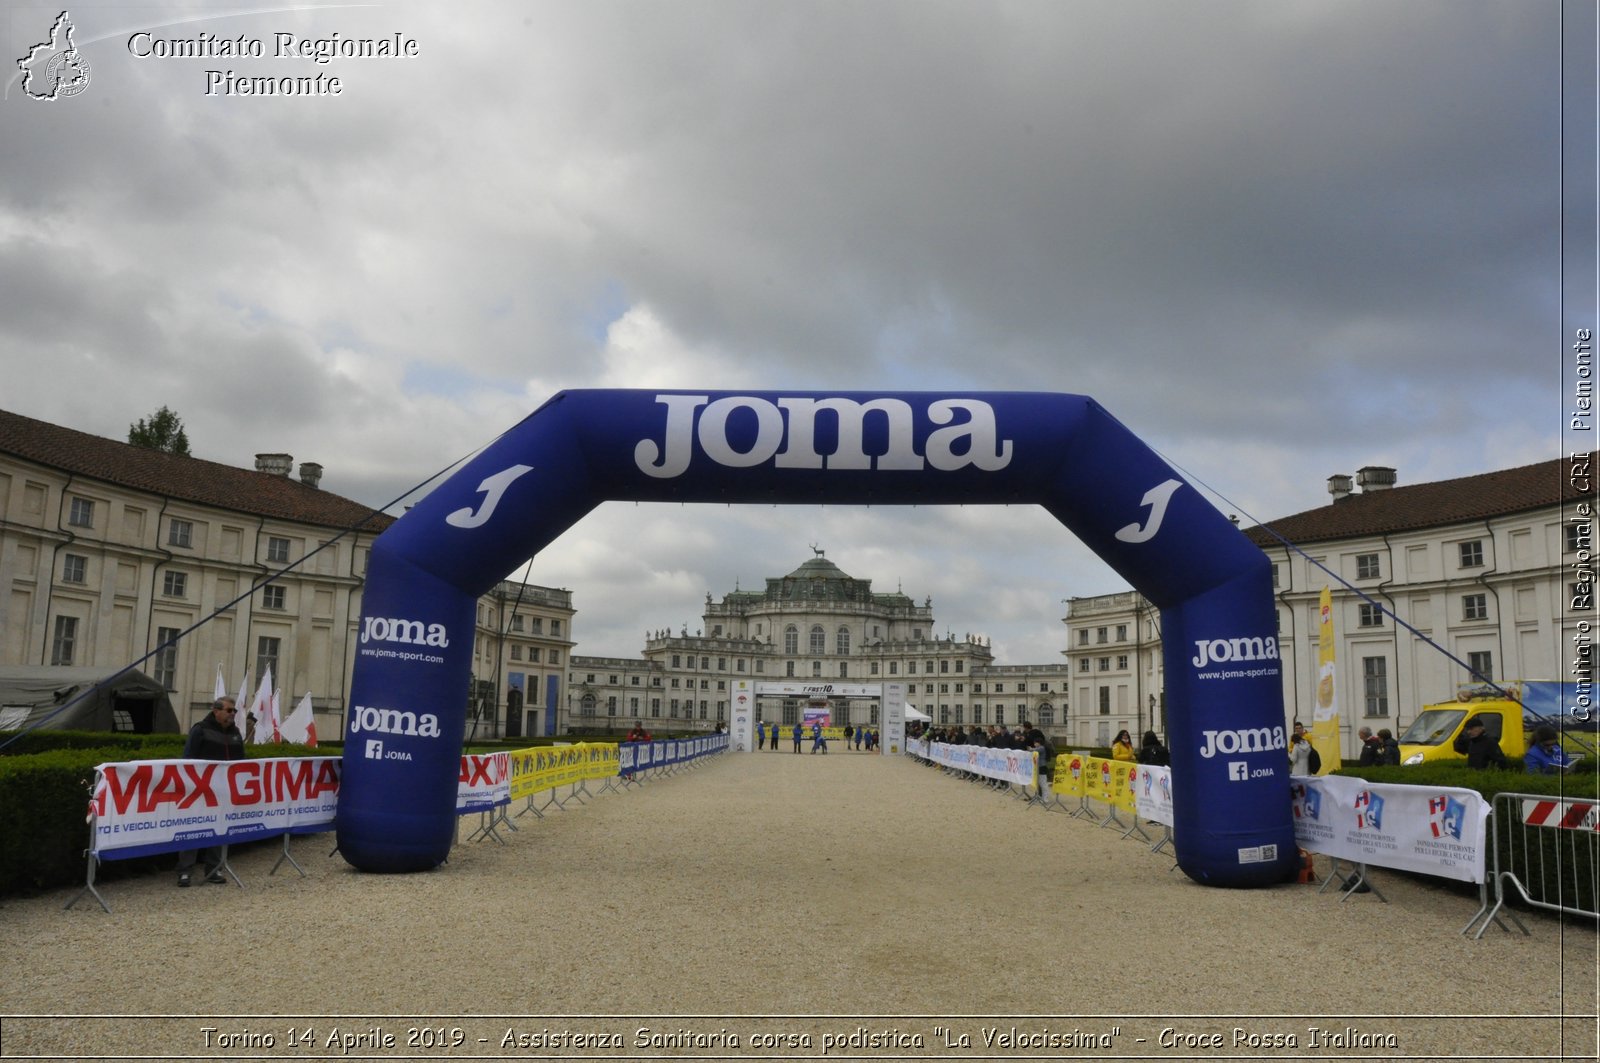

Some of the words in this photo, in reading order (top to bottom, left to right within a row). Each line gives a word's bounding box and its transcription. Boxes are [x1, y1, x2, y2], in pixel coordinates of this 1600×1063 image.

[361, 648, 444, 663] www.joma-sport.com
[1197, 668, 1279, 680] www.joma-sport.com
[384, 751, 413, 761] JOMA
[1250, 767, 1275, 779] JOMA
[224, 809, 265, 822] NOLEGGIO
[265, 807, 285, 818] AUTO
[287, 806, 293, 815] E
[294, 805, 320, 815] VEICOLI
[114, 824, 120, 833] E
[122, 821, 158, 832] VEICOLI
[159, 814, 217, 828] COMMERCIALI
[228, 824, 265, 836] gimaxrent.it
